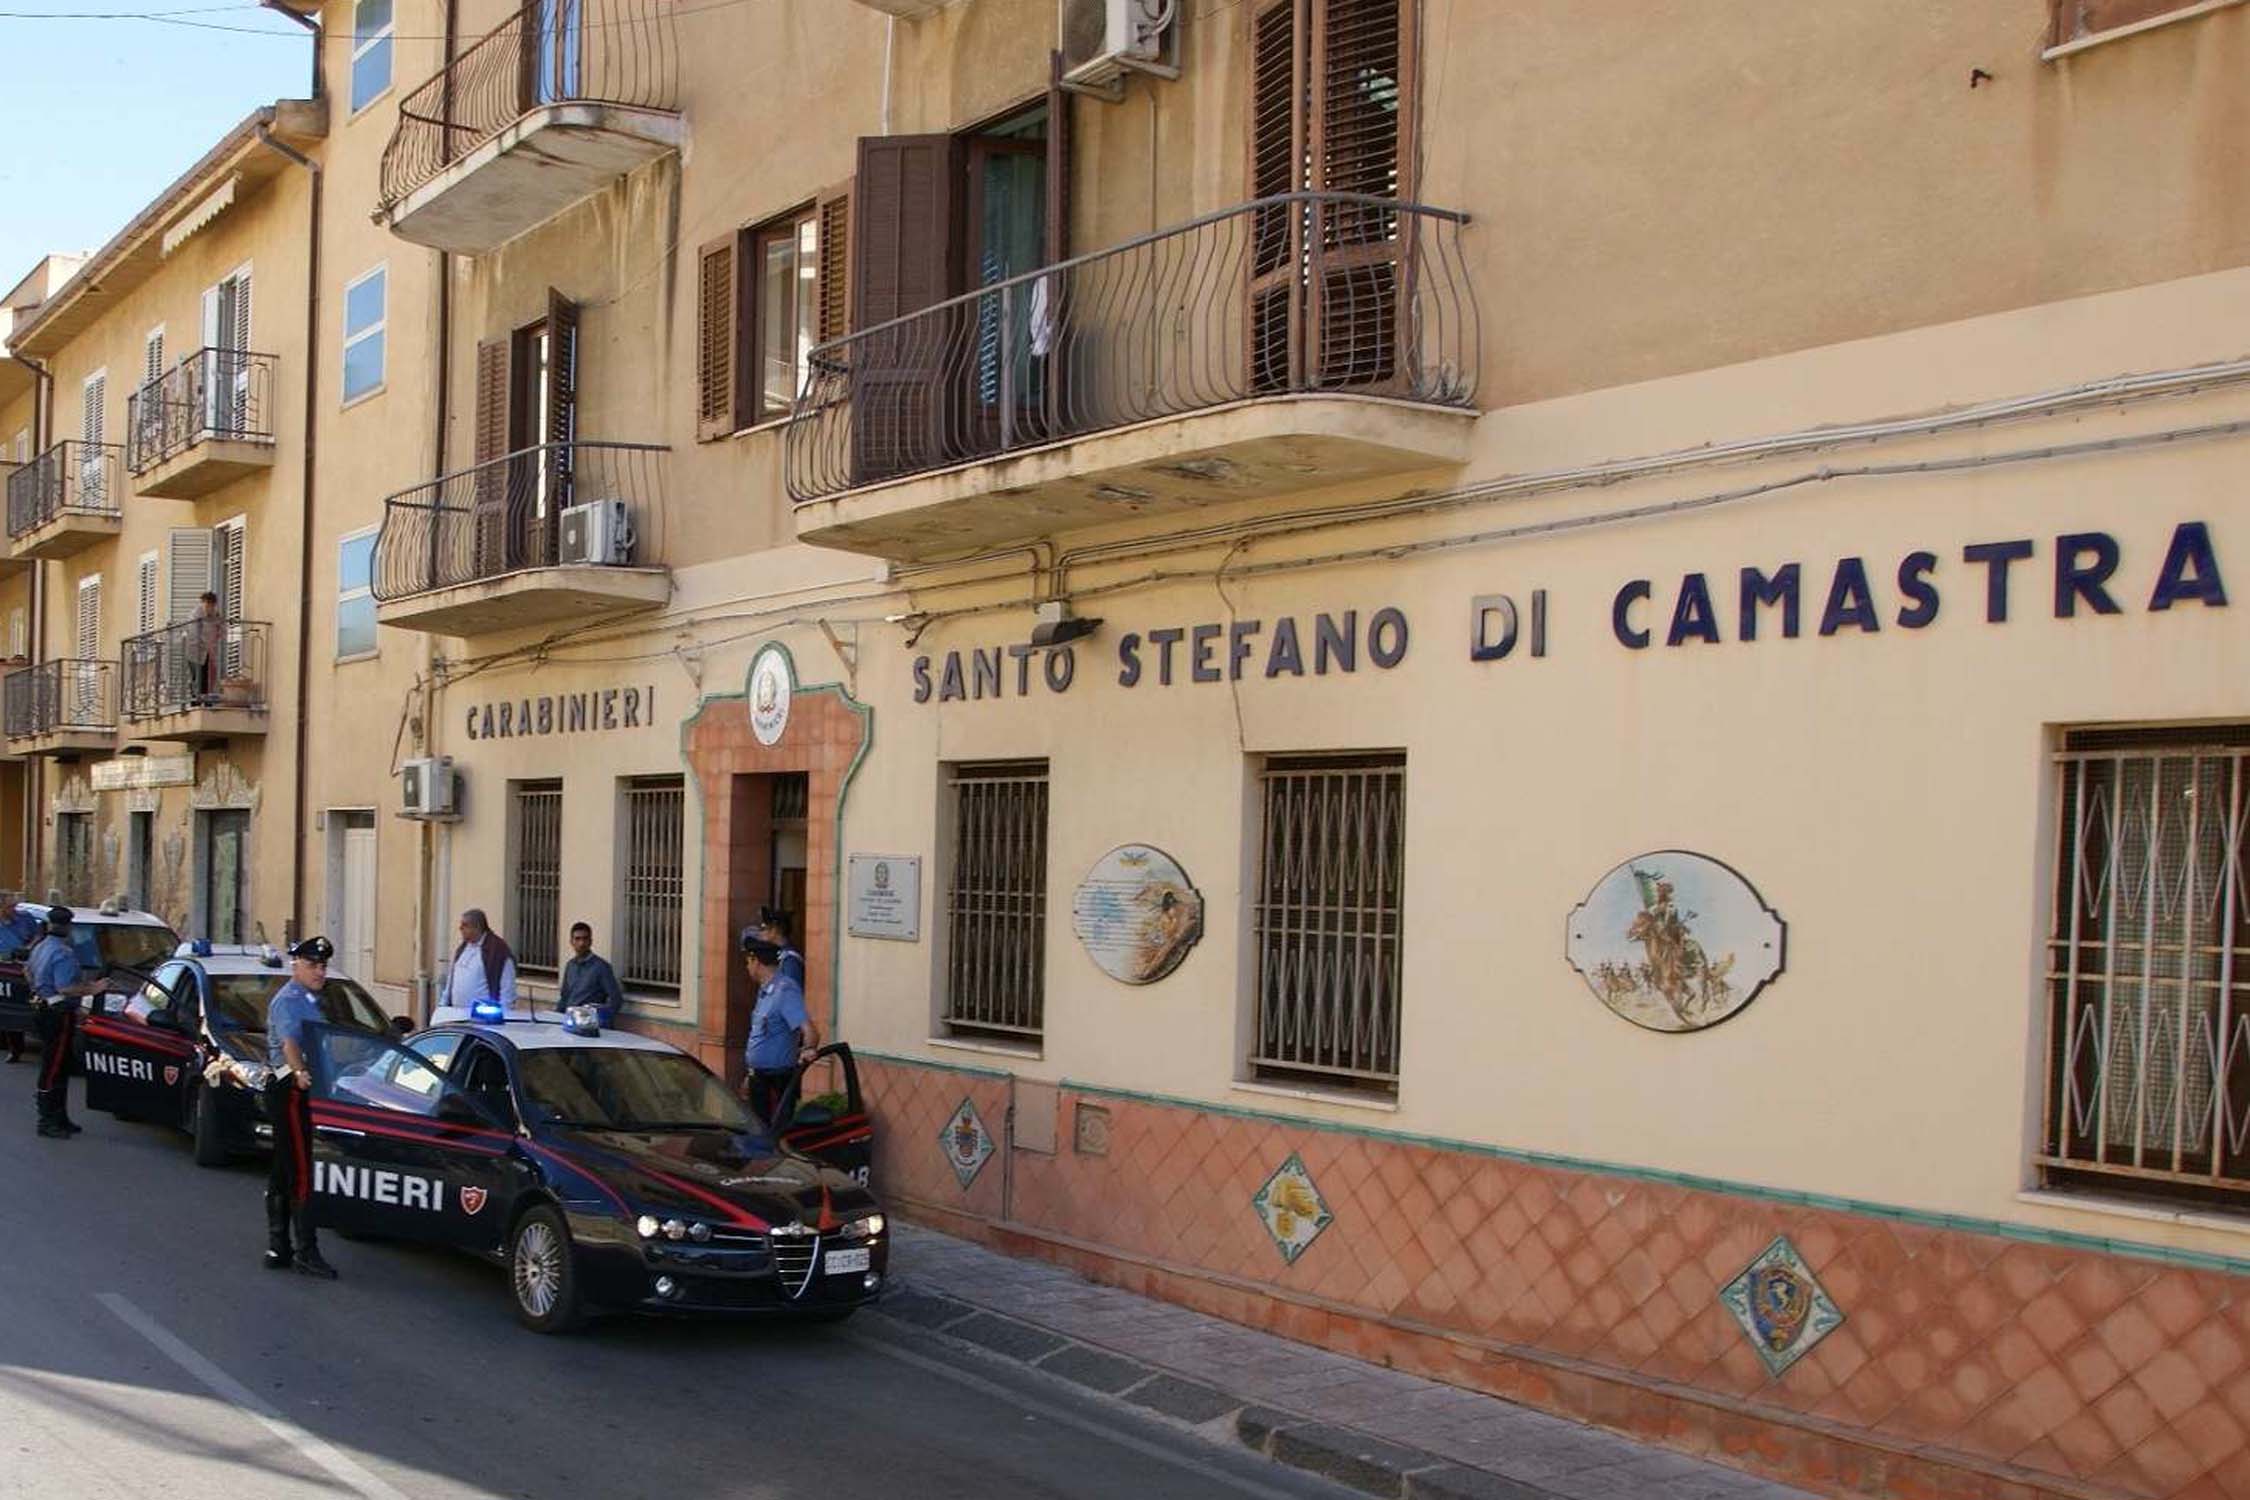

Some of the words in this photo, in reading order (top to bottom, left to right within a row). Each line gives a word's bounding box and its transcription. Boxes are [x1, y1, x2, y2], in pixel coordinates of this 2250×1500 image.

[913, 643, 1076, 703] SANTO
[1118, 606, 1409, 687] STEFANO
[1471, 588, 1547, 663] DI
[1612, 521, 2229, 650] CAMASTRA
[467, 686, 654, 740] CARABINIERI
[85, 1051, 153, 1081] INIERI
[313, 1160, 444, 1212] INIERI
